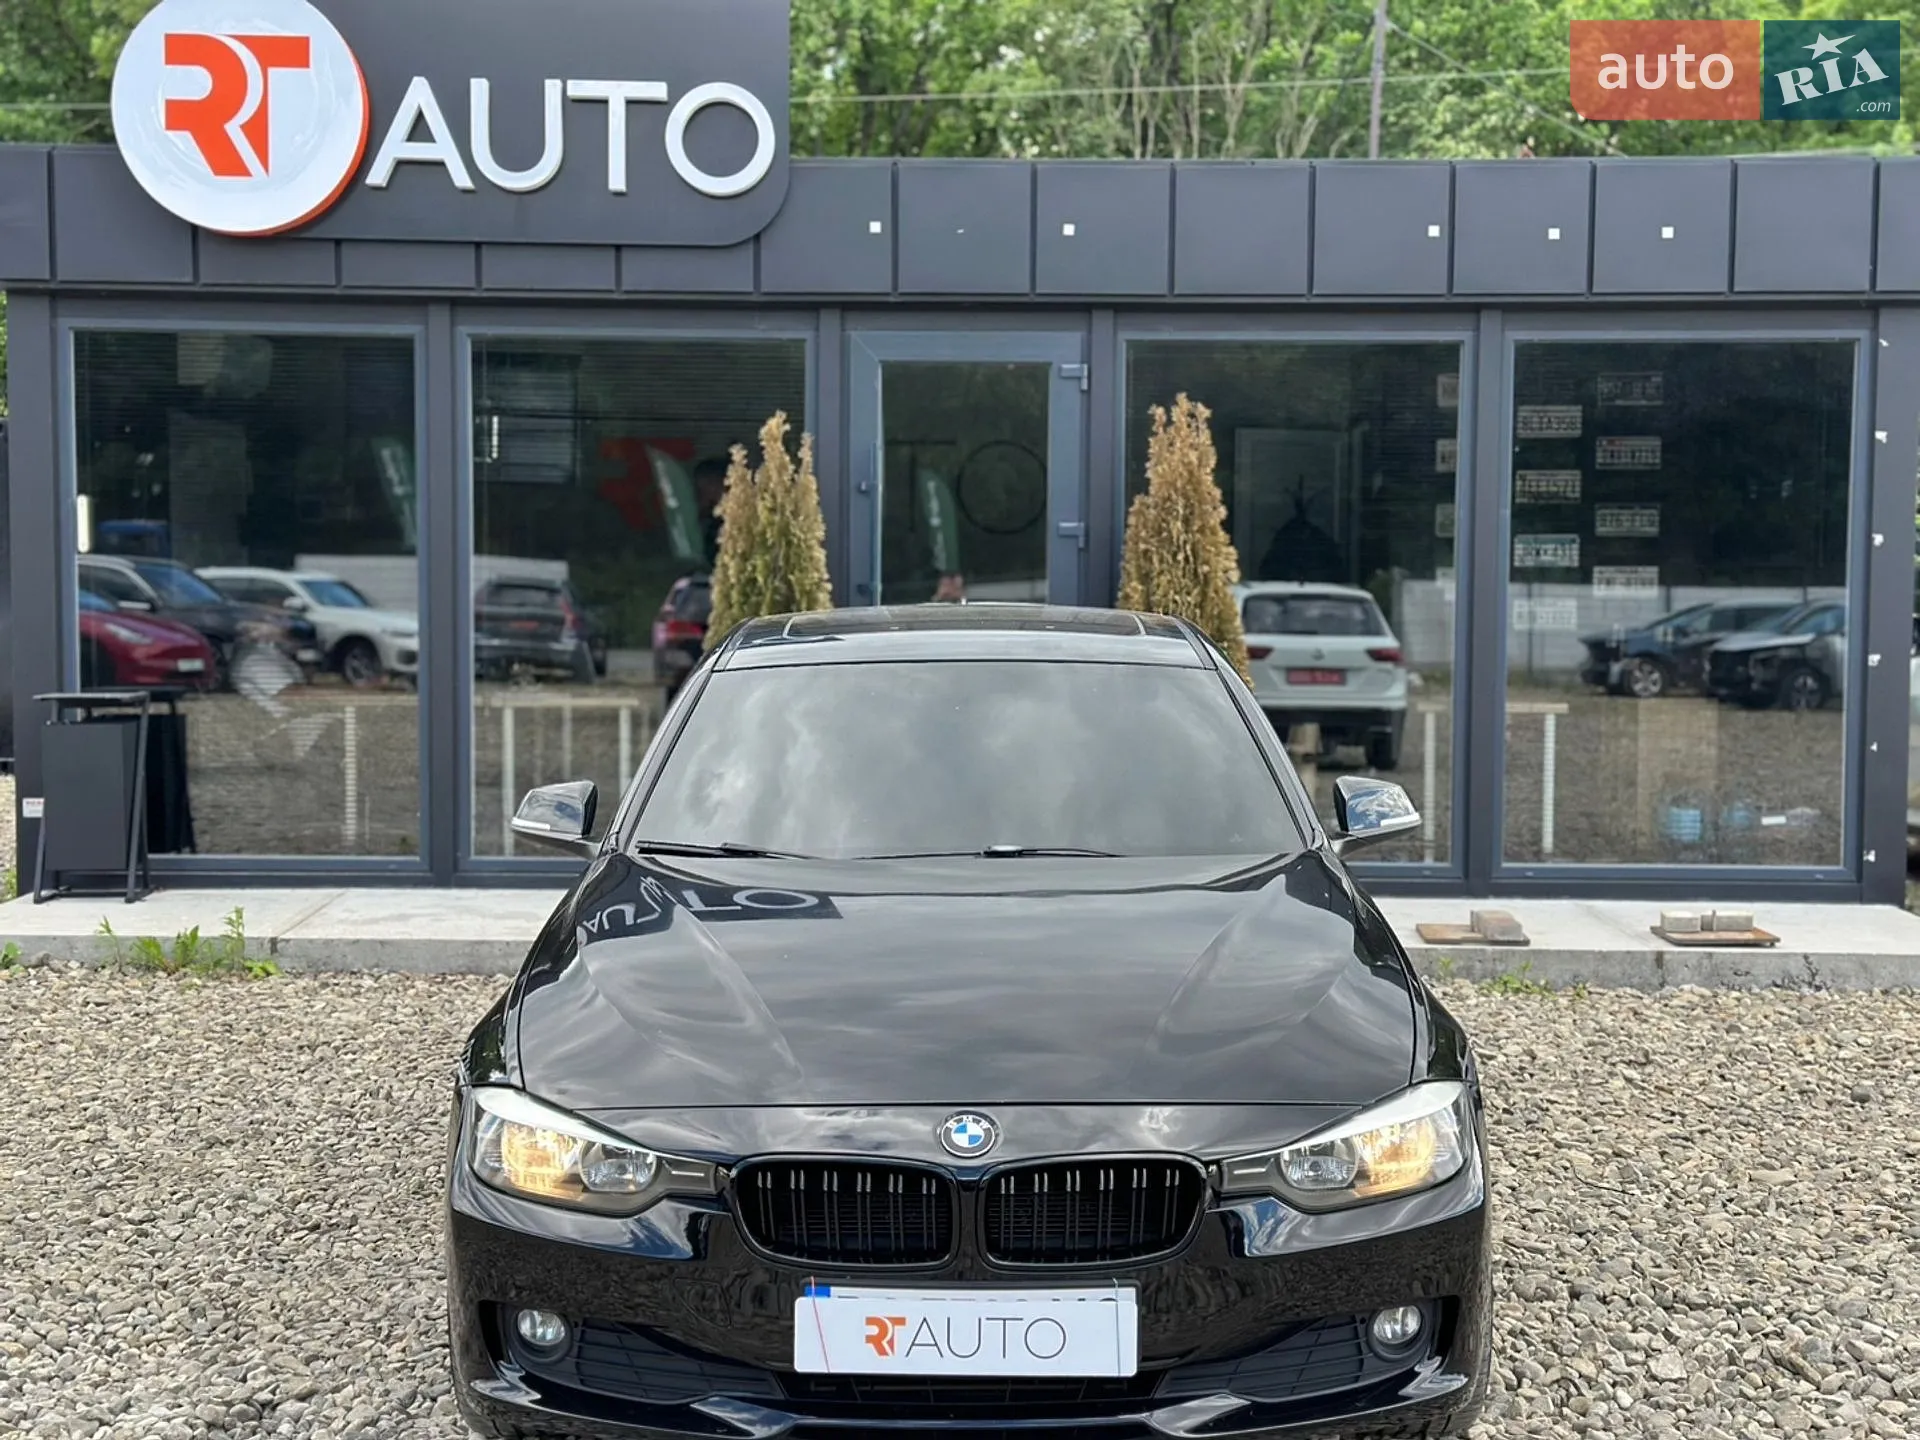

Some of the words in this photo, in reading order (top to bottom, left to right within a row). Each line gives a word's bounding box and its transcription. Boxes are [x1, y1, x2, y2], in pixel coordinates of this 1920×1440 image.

[165, 33, 310, 177] RT
[365, 76, 776, 197] AUTO
[906, 1316, 1067, 1359] AUTO
